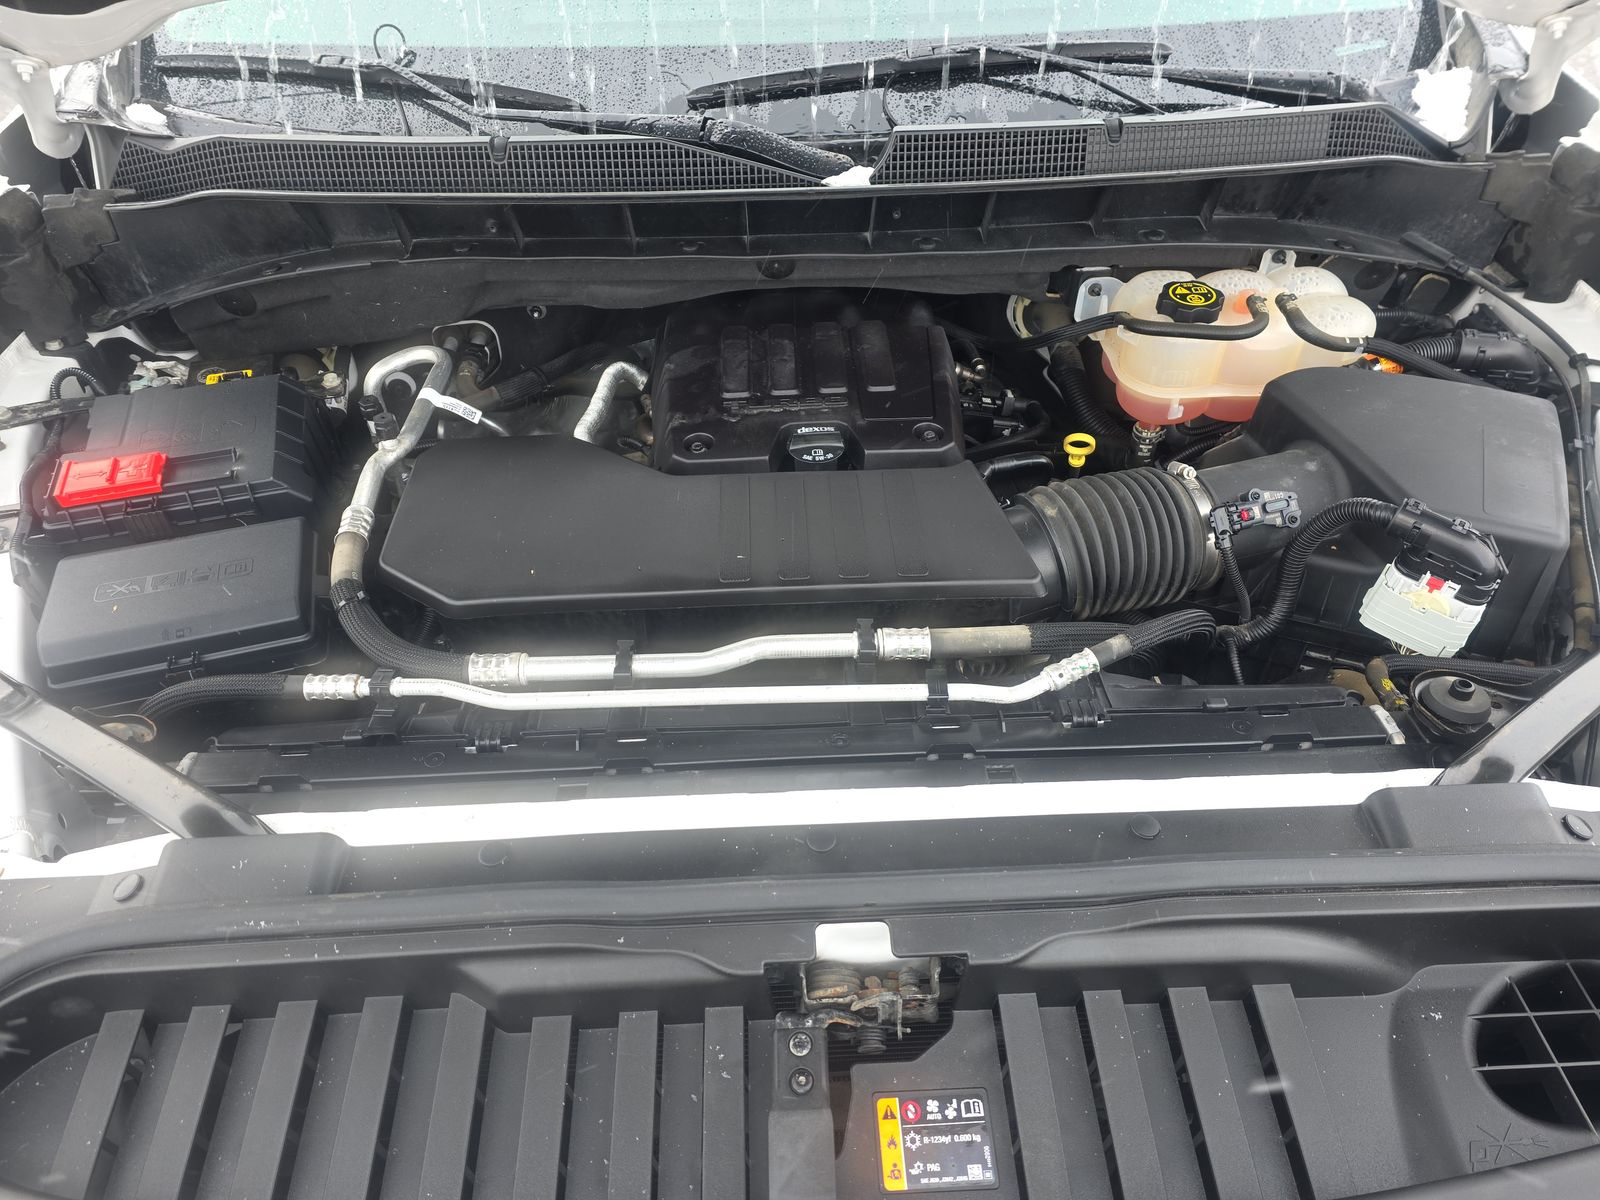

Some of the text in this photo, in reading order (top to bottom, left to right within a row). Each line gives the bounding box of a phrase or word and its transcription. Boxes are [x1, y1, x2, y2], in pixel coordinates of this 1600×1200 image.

[797, 426, 835, 434] dexos
[923, 1134, 952, 1144] R-1234yf
[973, 1133, 981, 1142] kg
[926, 1163, 941, 1172] PAG
